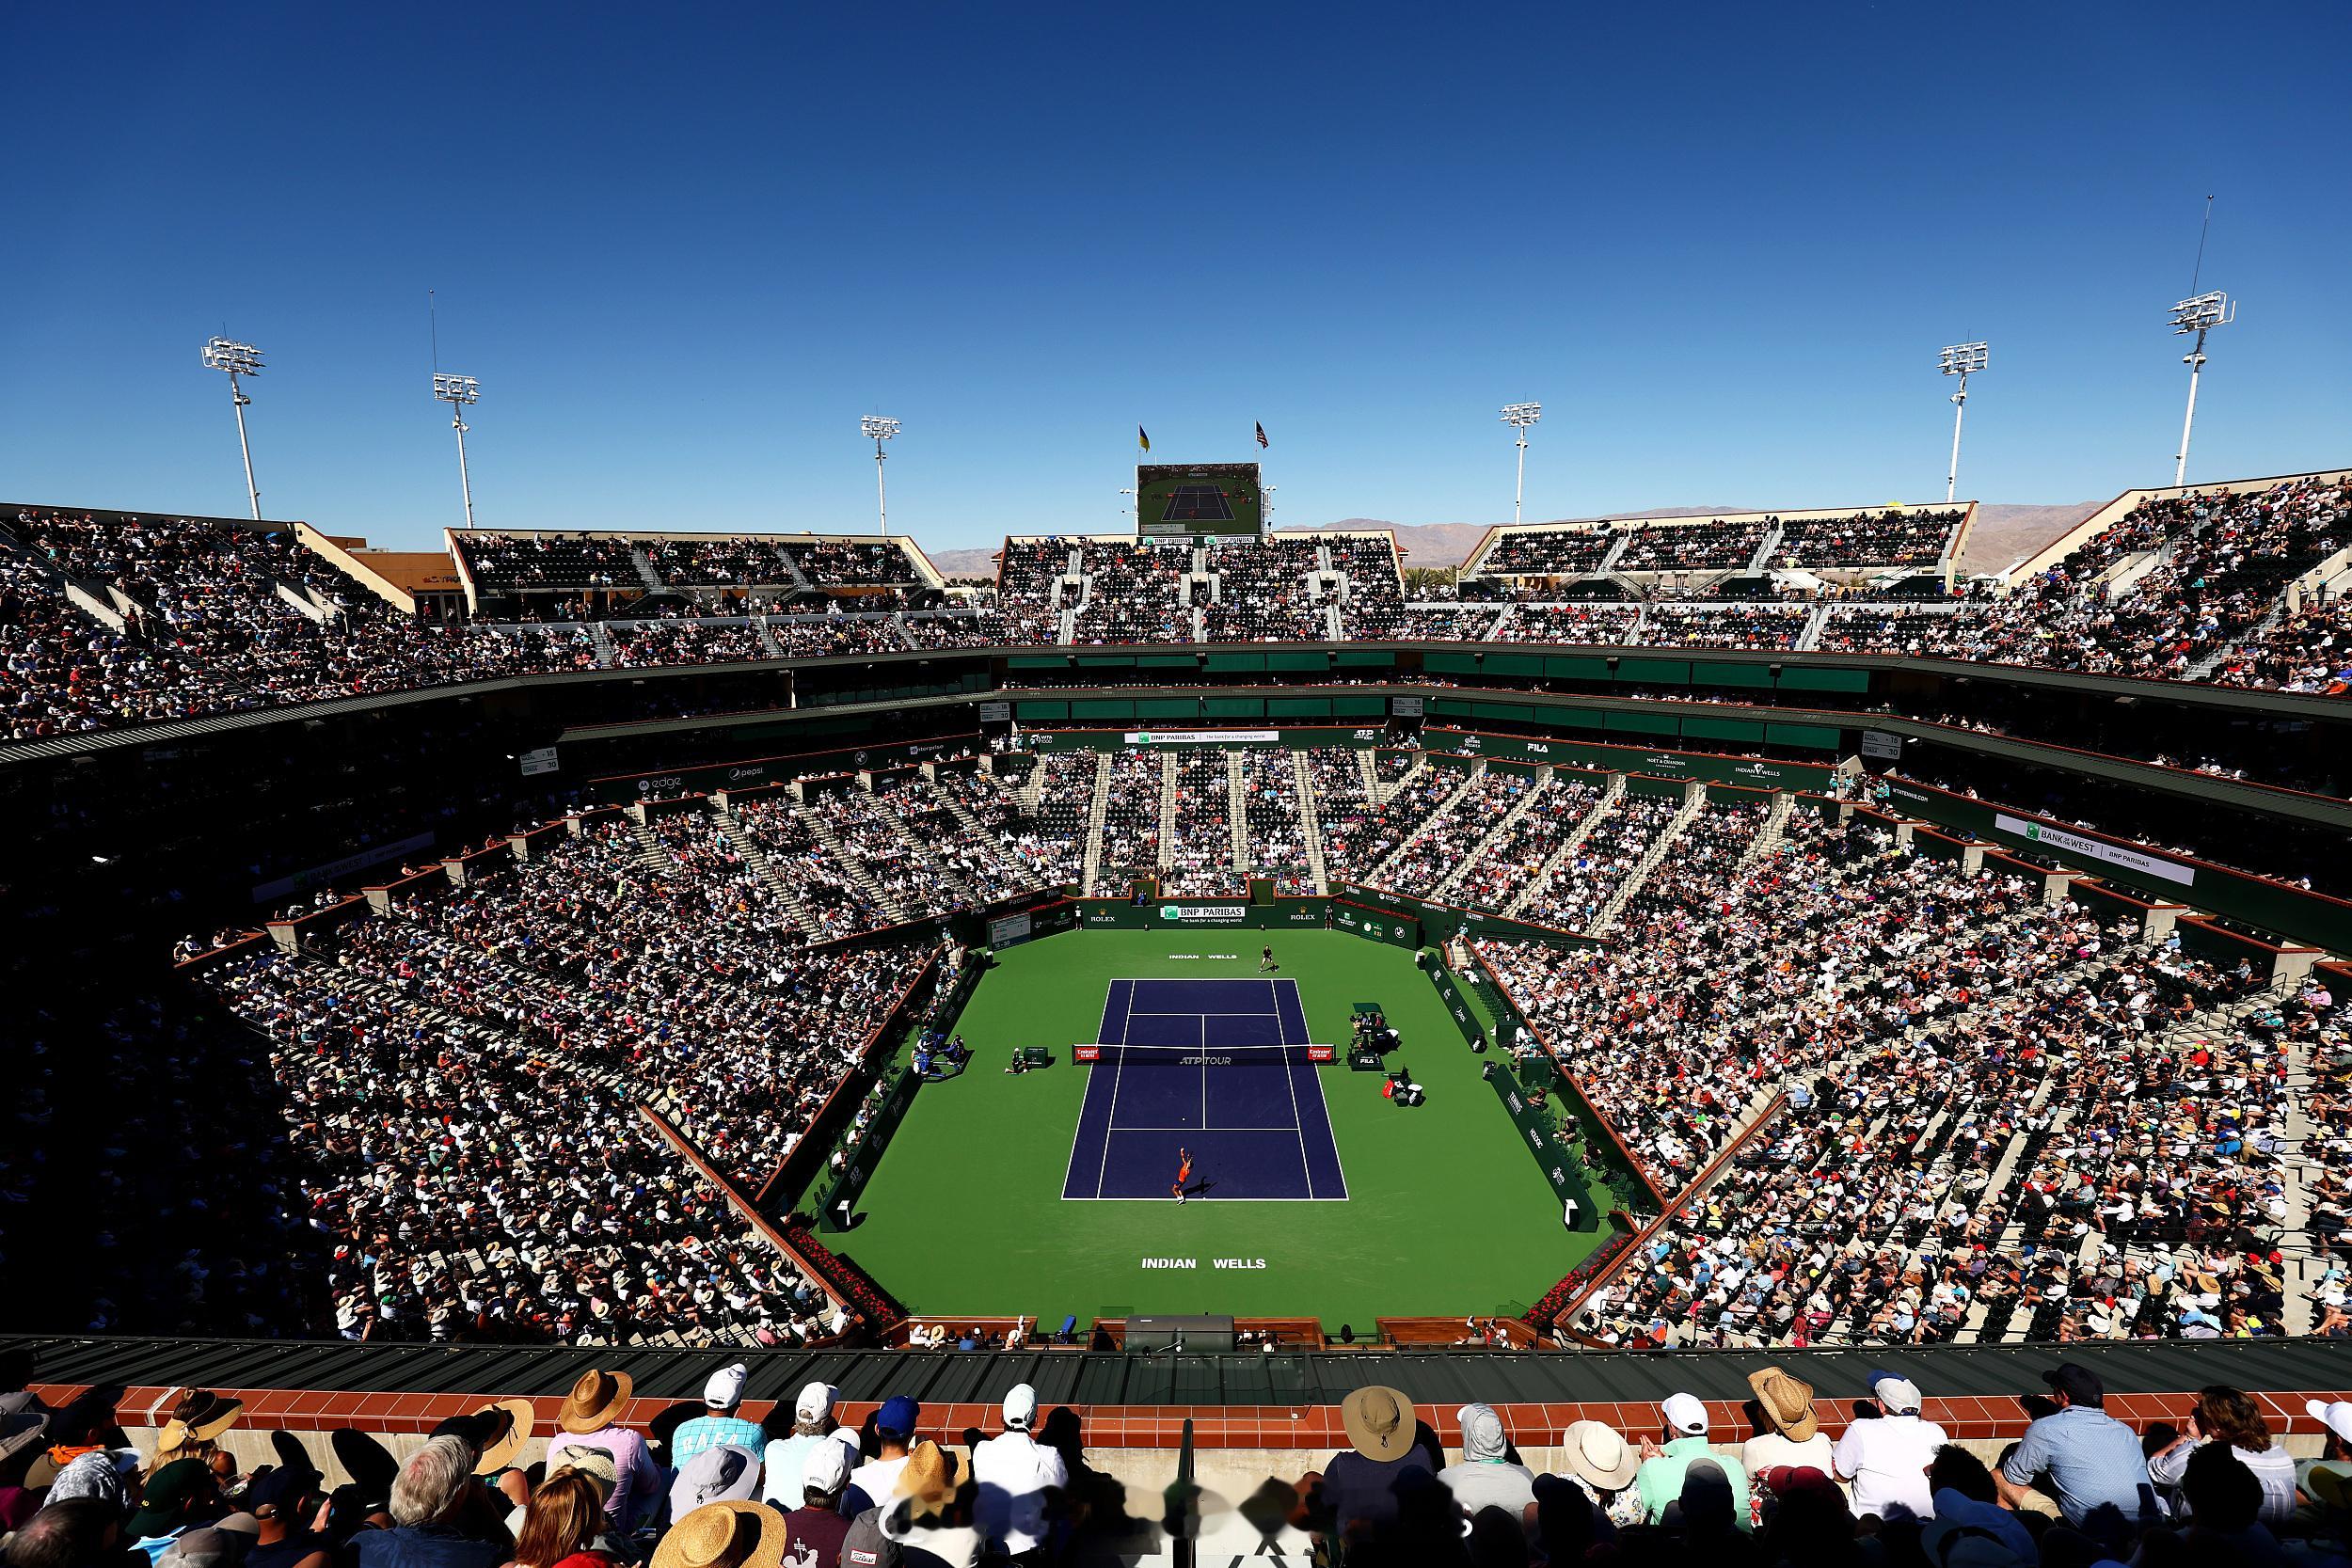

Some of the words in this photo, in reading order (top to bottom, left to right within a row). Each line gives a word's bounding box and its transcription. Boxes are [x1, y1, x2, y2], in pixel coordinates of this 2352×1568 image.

[1527, 743, 1549, 752] FILA
[741, 767, 763, 778] pepsi
[651, 777, 682, 789] edge
[2041, 830, 2063, 844] BANK
[2071, 838, 2095, 852] WEST
[2122, 855, 2150, 867] PARIBAS
[1385, 895, 1401, 904] edge
[1181, 908, 1200, 916] BNP
[1203, 908, 1242, 916] PARIBAS
[1180, 1056, 1202, 1065] ATP
[1204, 1056, 1232, 1065] TOUR
[1509, 1090, 1523, 1113] TENNIS
[1141, 1258, 1197, 1269] INDIAN
[1213, 1259, 1266, 1269] WELLS
[683, 1432, 739, 1454] RAFA
